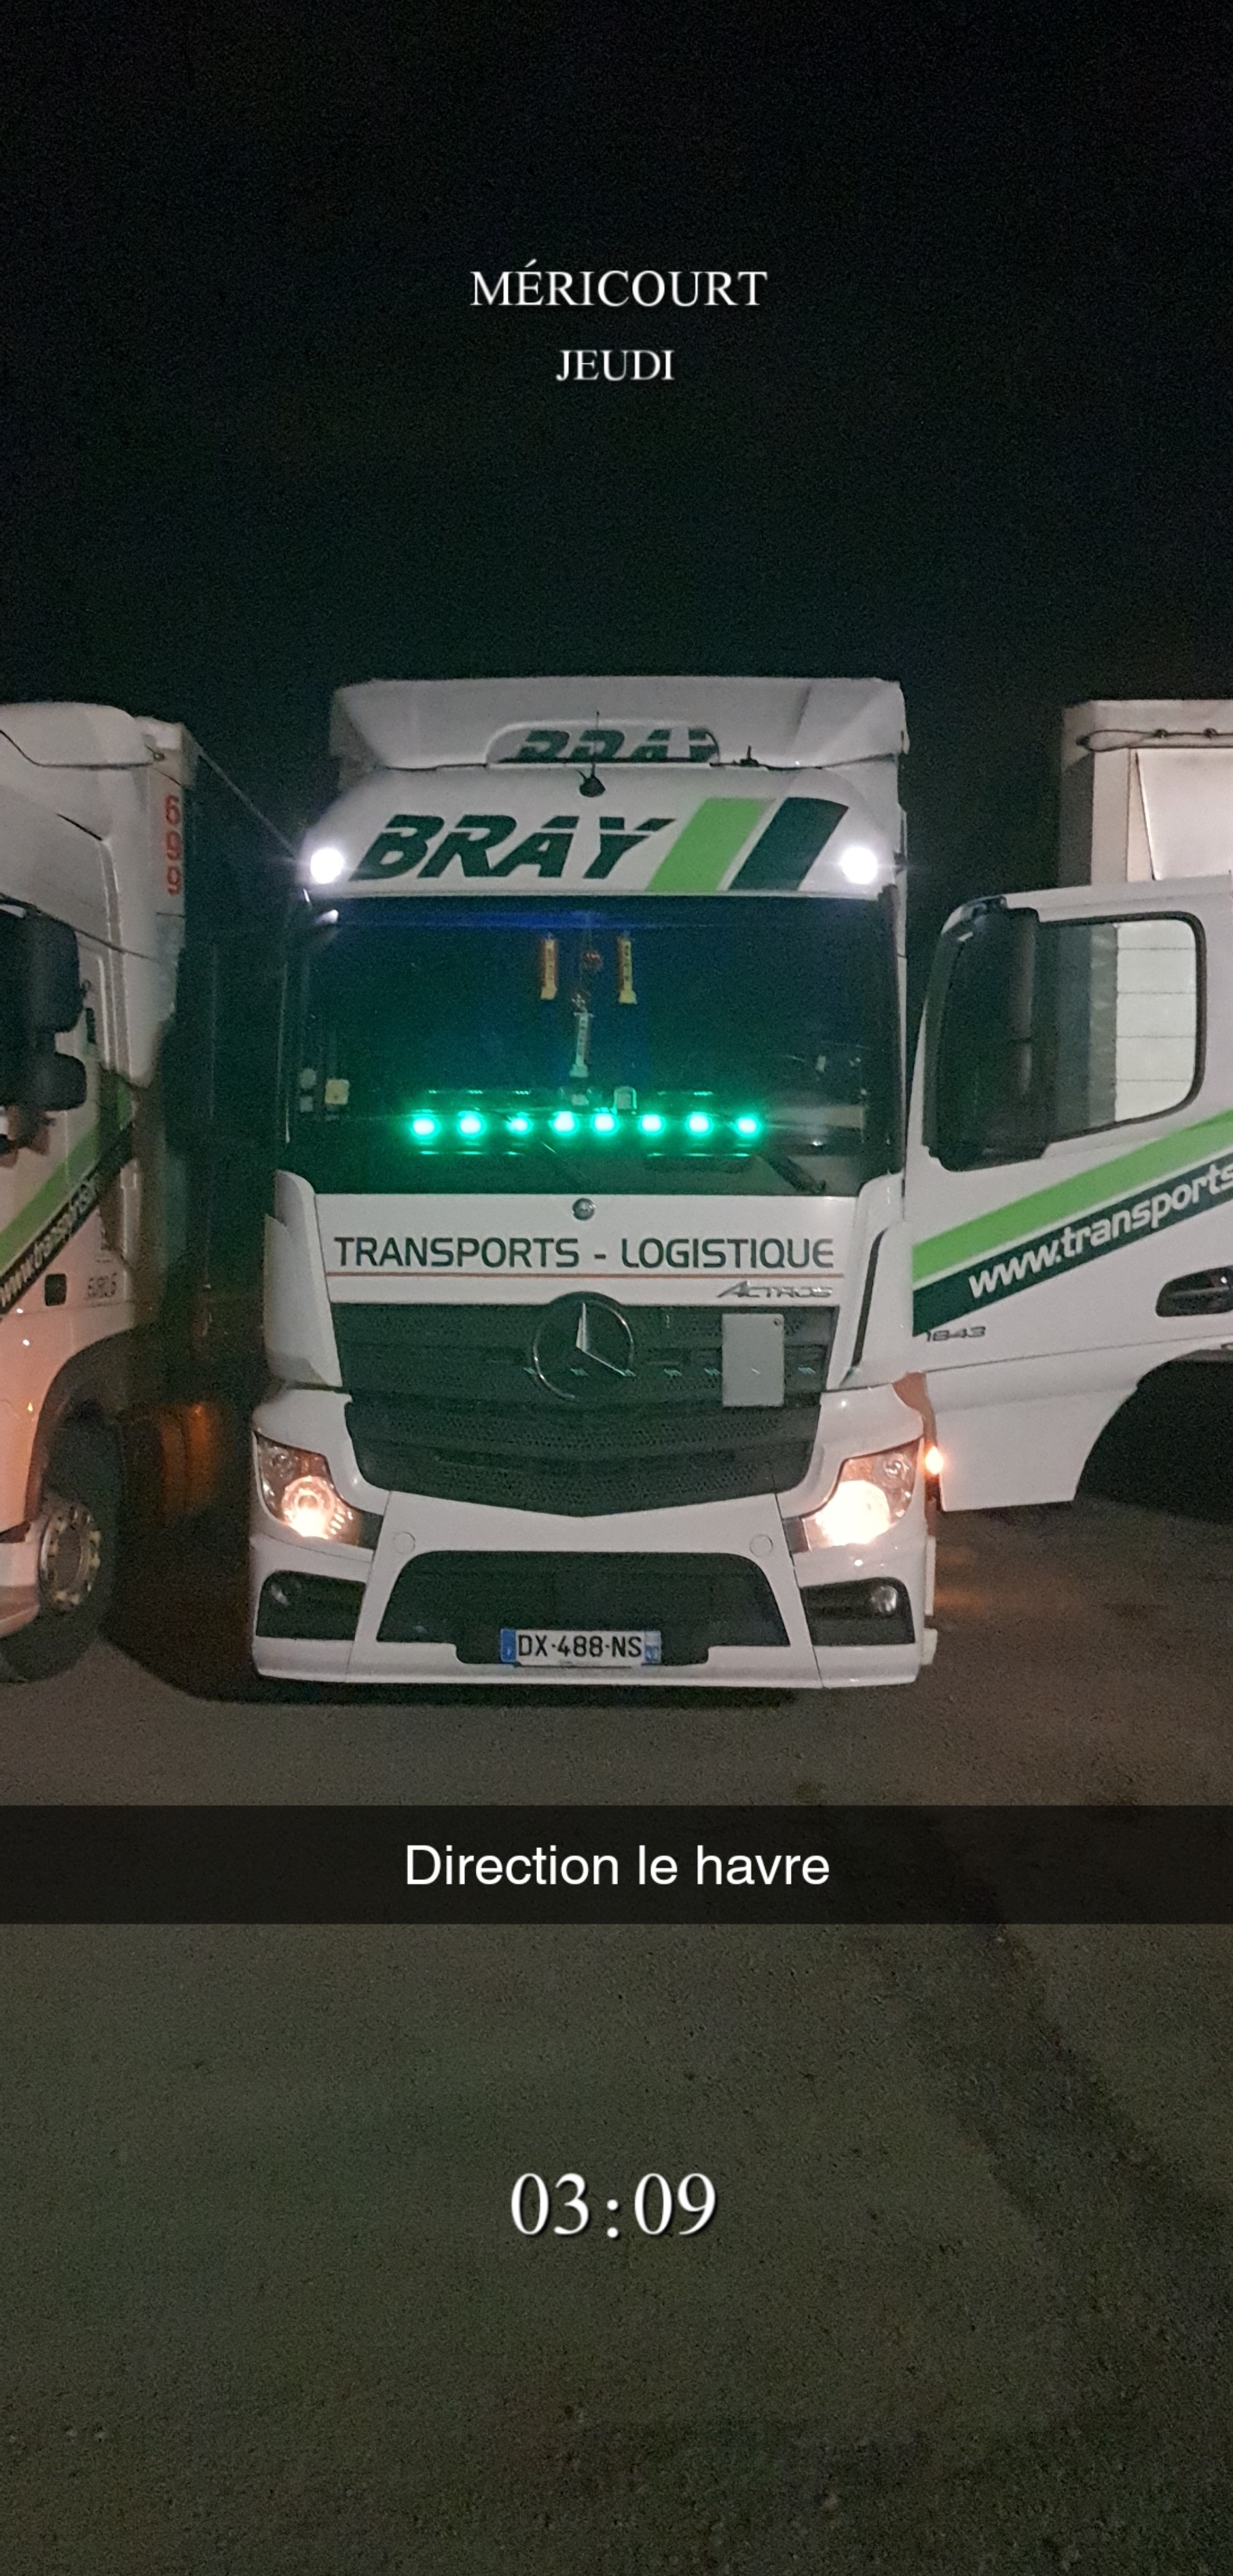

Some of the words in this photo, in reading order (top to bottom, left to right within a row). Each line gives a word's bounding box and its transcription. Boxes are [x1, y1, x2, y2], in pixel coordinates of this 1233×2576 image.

[164, 795, 181, 895] 699
[348, 814, 676, 882] BRAY
[334, 1236, 580, 1269] TRANSPORTS
[621, 1237, 834, 1269] LOGISTIQUE
[926, 1326, 987, 1342] 1843
[518, 1634, 642, 1658] DX-488-NS
